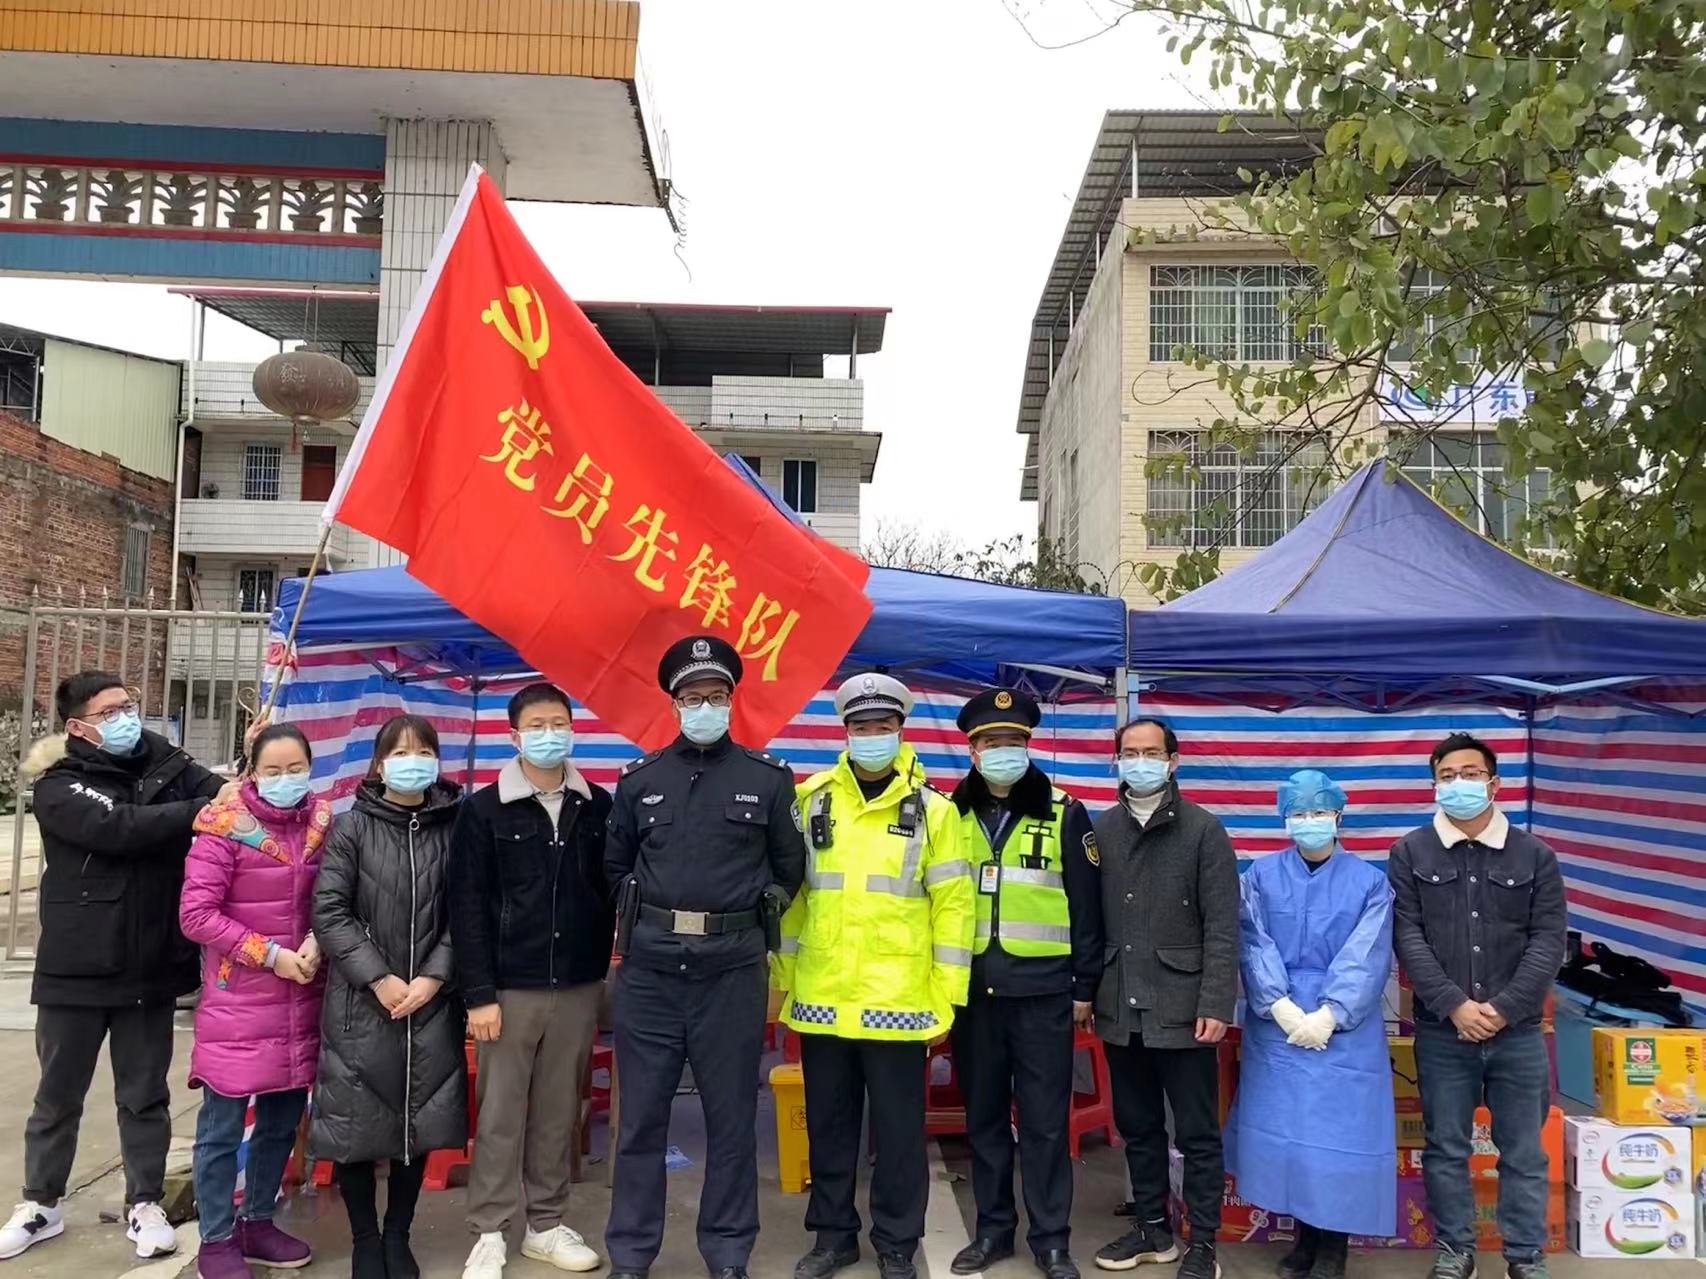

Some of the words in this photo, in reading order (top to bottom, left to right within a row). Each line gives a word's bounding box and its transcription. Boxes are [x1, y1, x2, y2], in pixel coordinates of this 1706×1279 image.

[478, 397, 800, 681] 党员先锋队
[1619, 1143, 1659, 1158] 纯牛奶
[1622, 1208, 1662, 1223] 纯牛奶
